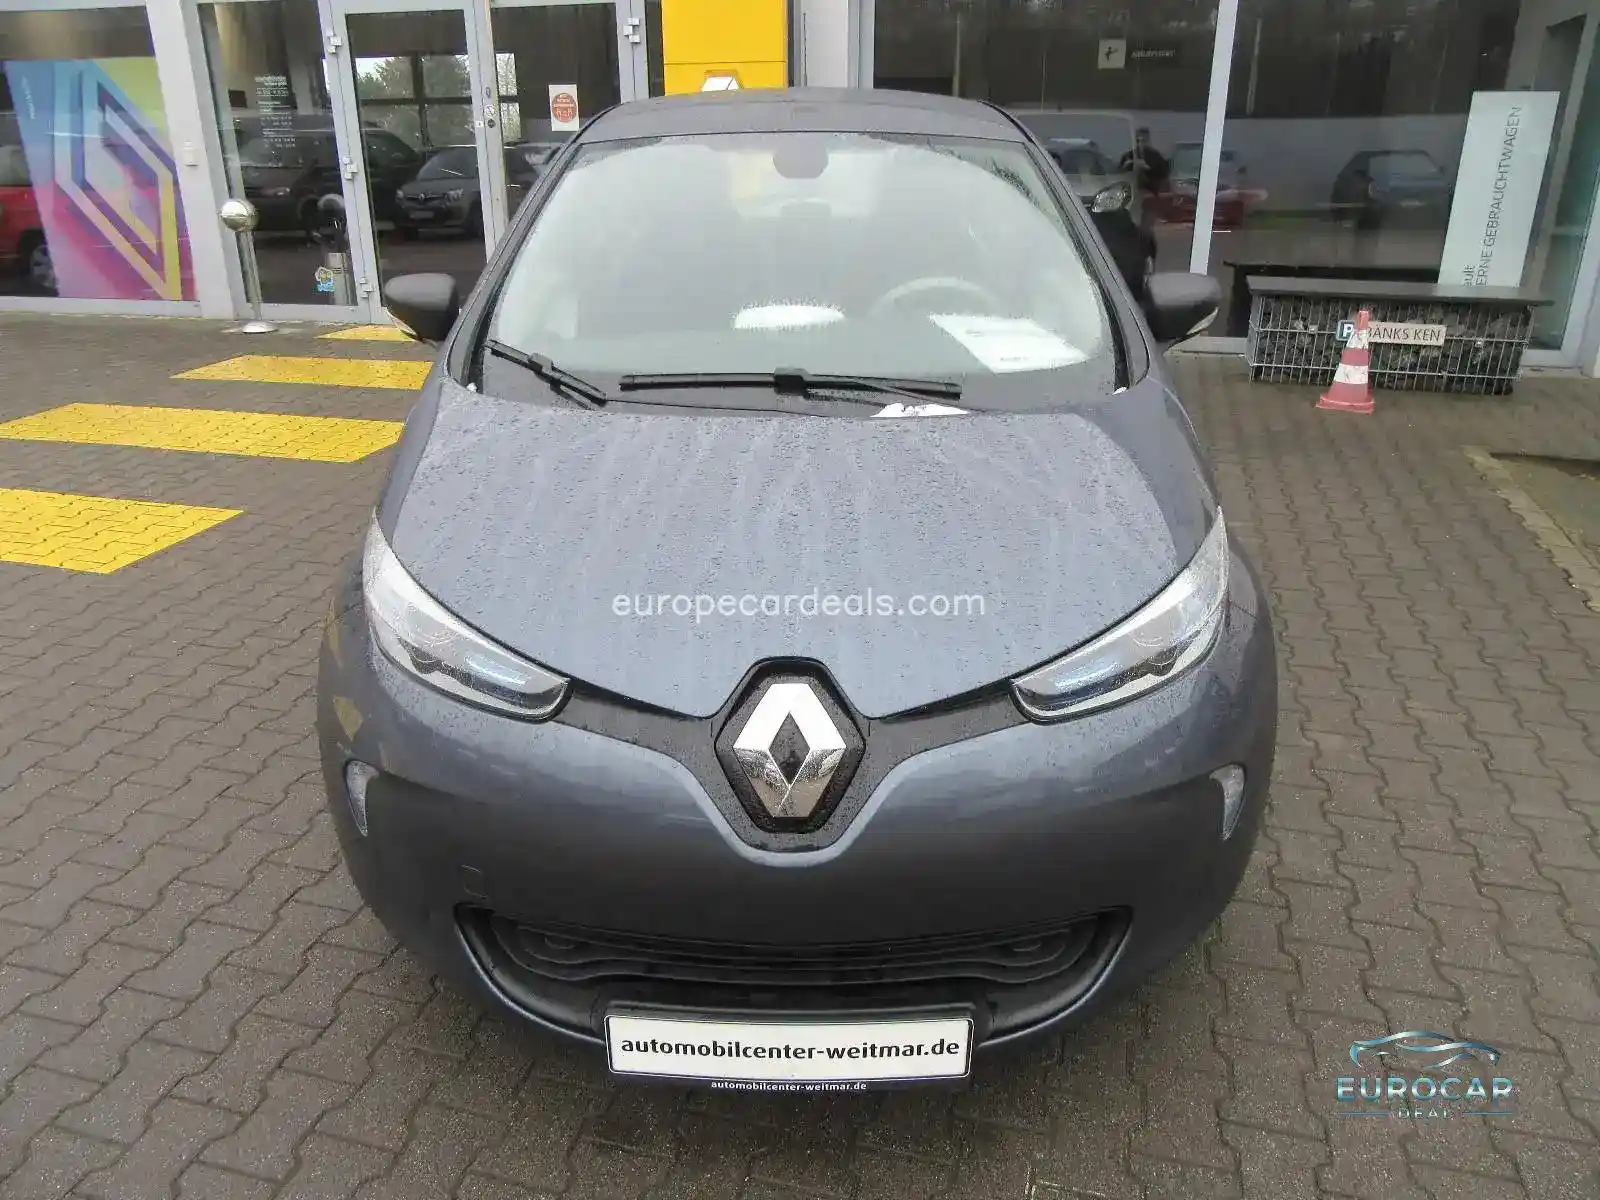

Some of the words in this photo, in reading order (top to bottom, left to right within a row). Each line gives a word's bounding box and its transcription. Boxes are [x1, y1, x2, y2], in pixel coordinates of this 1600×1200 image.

[1483, 105, 1523, 246] GEBRAUCHTWAGEN
[1414, 328, 1440, 341] KEN
[621, 1036, 960, 1060] automobilcenter-weitmar.de
[711, 1080, 867, 1092] automobilcenter-weitmar.de
